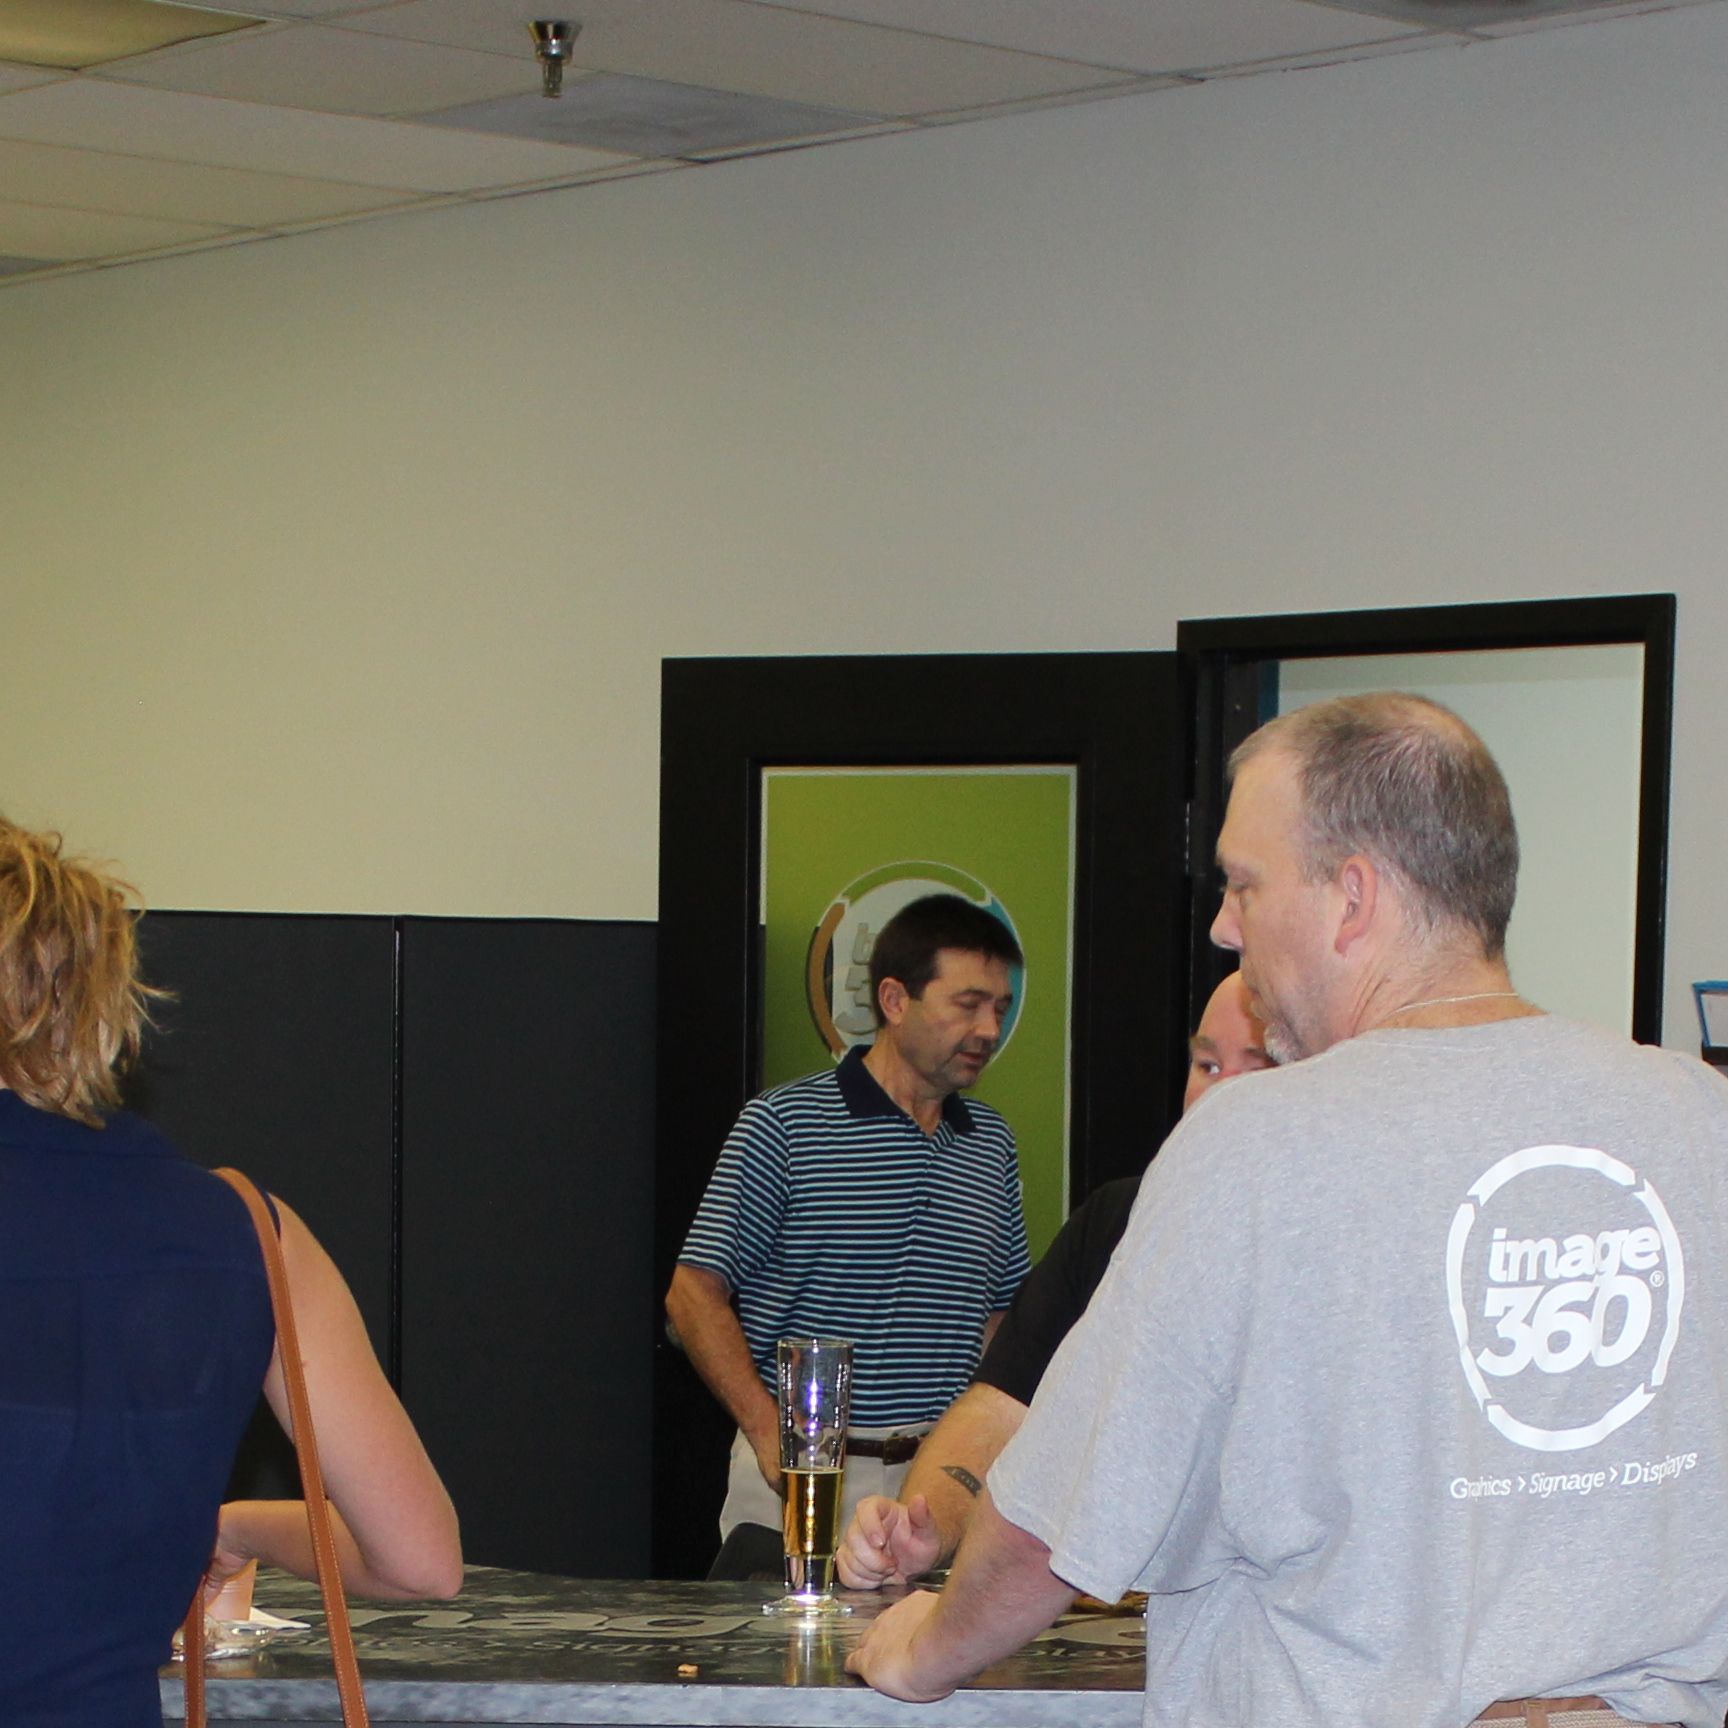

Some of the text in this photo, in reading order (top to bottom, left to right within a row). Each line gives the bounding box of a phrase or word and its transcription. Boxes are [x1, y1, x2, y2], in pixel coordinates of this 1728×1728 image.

[1487, 1225, 1662, 1283] image
[1476, 1274, 1652, 1377] 360
[1529, 1471, 1606, 1498] Signage
